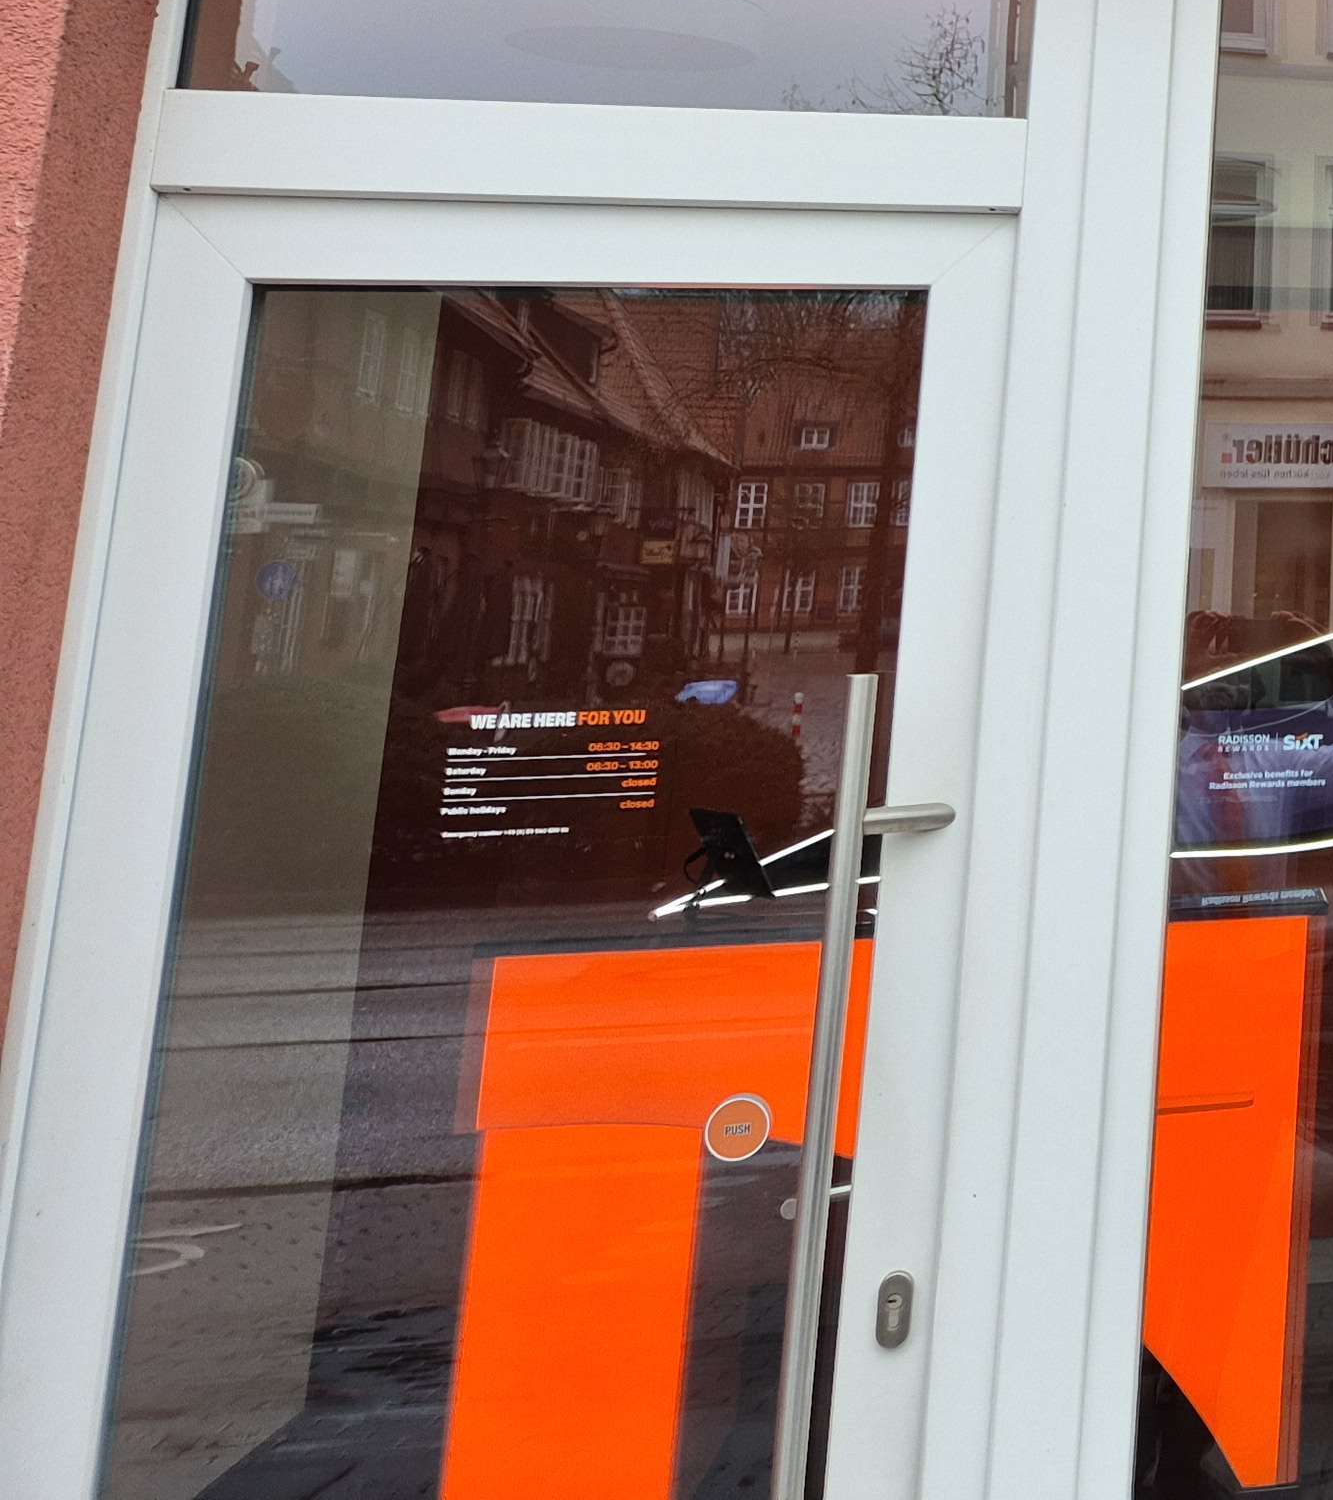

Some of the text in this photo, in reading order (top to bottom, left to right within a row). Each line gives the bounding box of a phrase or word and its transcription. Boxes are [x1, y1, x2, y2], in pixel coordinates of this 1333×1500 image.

[470, 709, 647, 730] WE ARE HERE FOR YOU
[1217, 733, 1270, 745] RADISSON
[1223, 769, 1314, 780] Exclusive benefits for
[621, 777, 657, 788] closed
[619, 798, 655, 809] closed
[724, 1123, 751, 1137] PUSH
